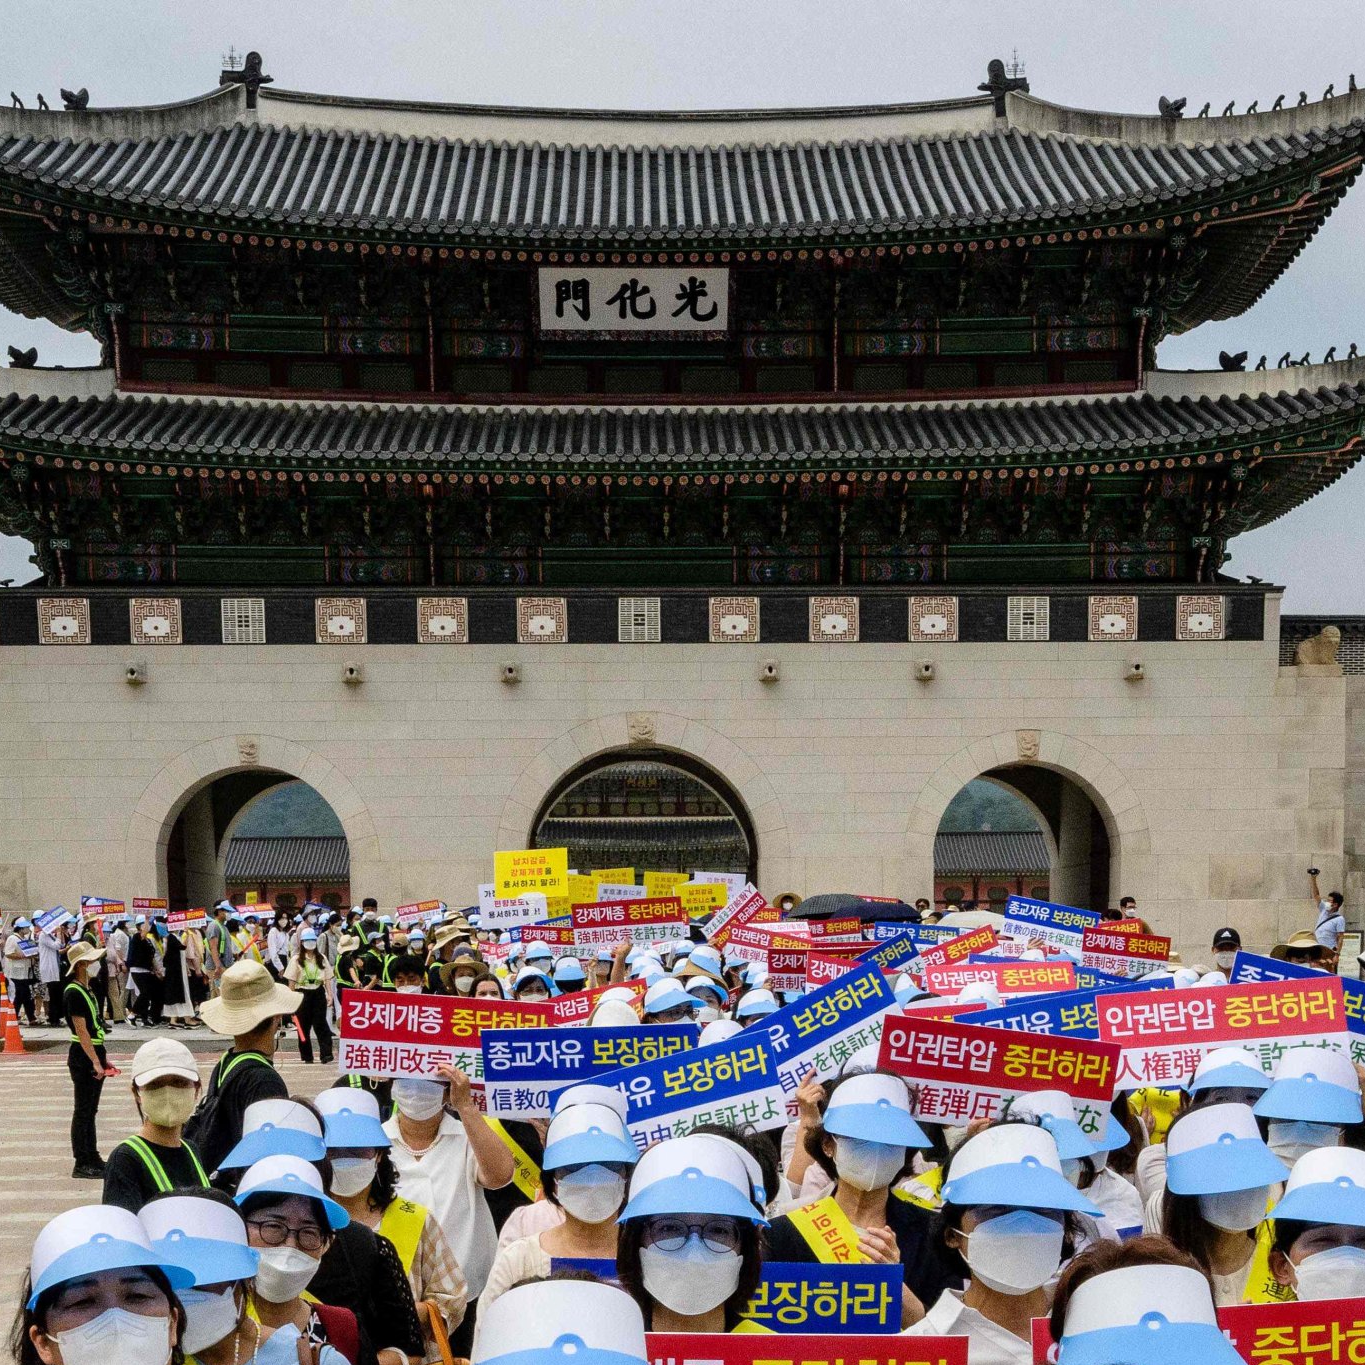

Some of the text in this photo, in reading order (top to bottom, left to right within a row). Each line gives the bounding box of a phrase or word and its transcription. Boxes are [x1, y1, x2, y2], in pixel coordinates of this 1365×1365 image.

[576, 906, 626, 923] 강제개종
[628, 902, 680, 919] 중단하라
[1008, 900, 1096, 928] 종교자유 보장하라
[523, 929, 558, 941] 강제개종
[577, 925, 682, 945] 強制改宗を許すな
[731, 928, 771, 947] 인권탄압
[947, 930, 994, 959] 중단하라
[1085, 932, 1168, 955] 강제개종 중단하라
[1002, 967, 1070, 988] 중단하라
[347, 1001, 443, 1034] 강제개종
[792, 972, 884, 1038] 보장하라
[1105, 989, 1337, 1038] 인권탄압 중단하라
[487, 1038, 585, 1070] 종교자유
[889, 1029, 1111, 1087] 인권탄압 중단하라
[663, 1044, 768, 1098] 보장하라
